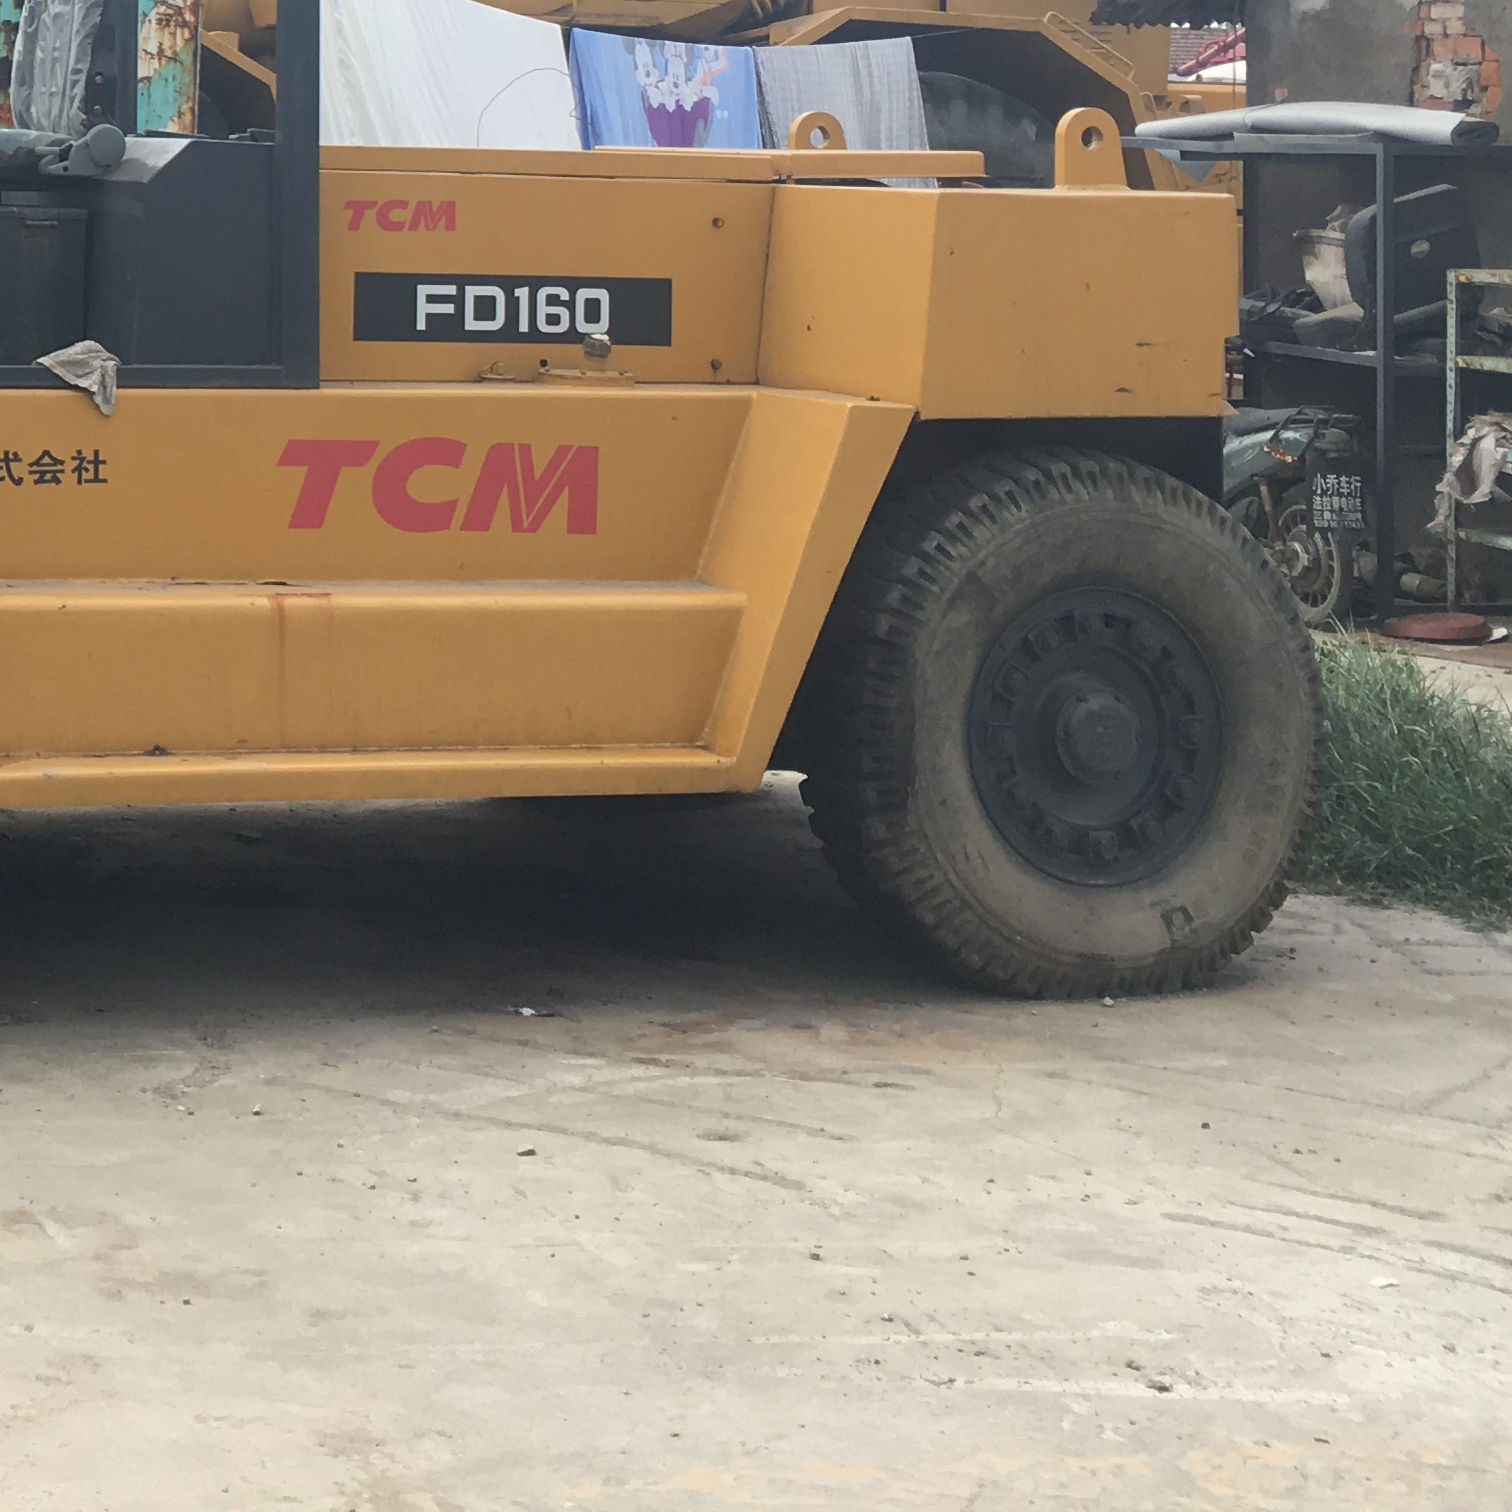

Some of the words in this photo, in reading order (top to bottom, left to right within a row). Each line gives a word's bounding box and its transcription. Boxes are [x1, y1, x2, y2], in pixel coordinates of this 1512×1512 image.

[343, 199, 457, 232] TCM
[415, 284, 610, 334] FD160
[276, 436, 600, 535] TCM
[1311, 473, 1362, 496] 小乔车行
